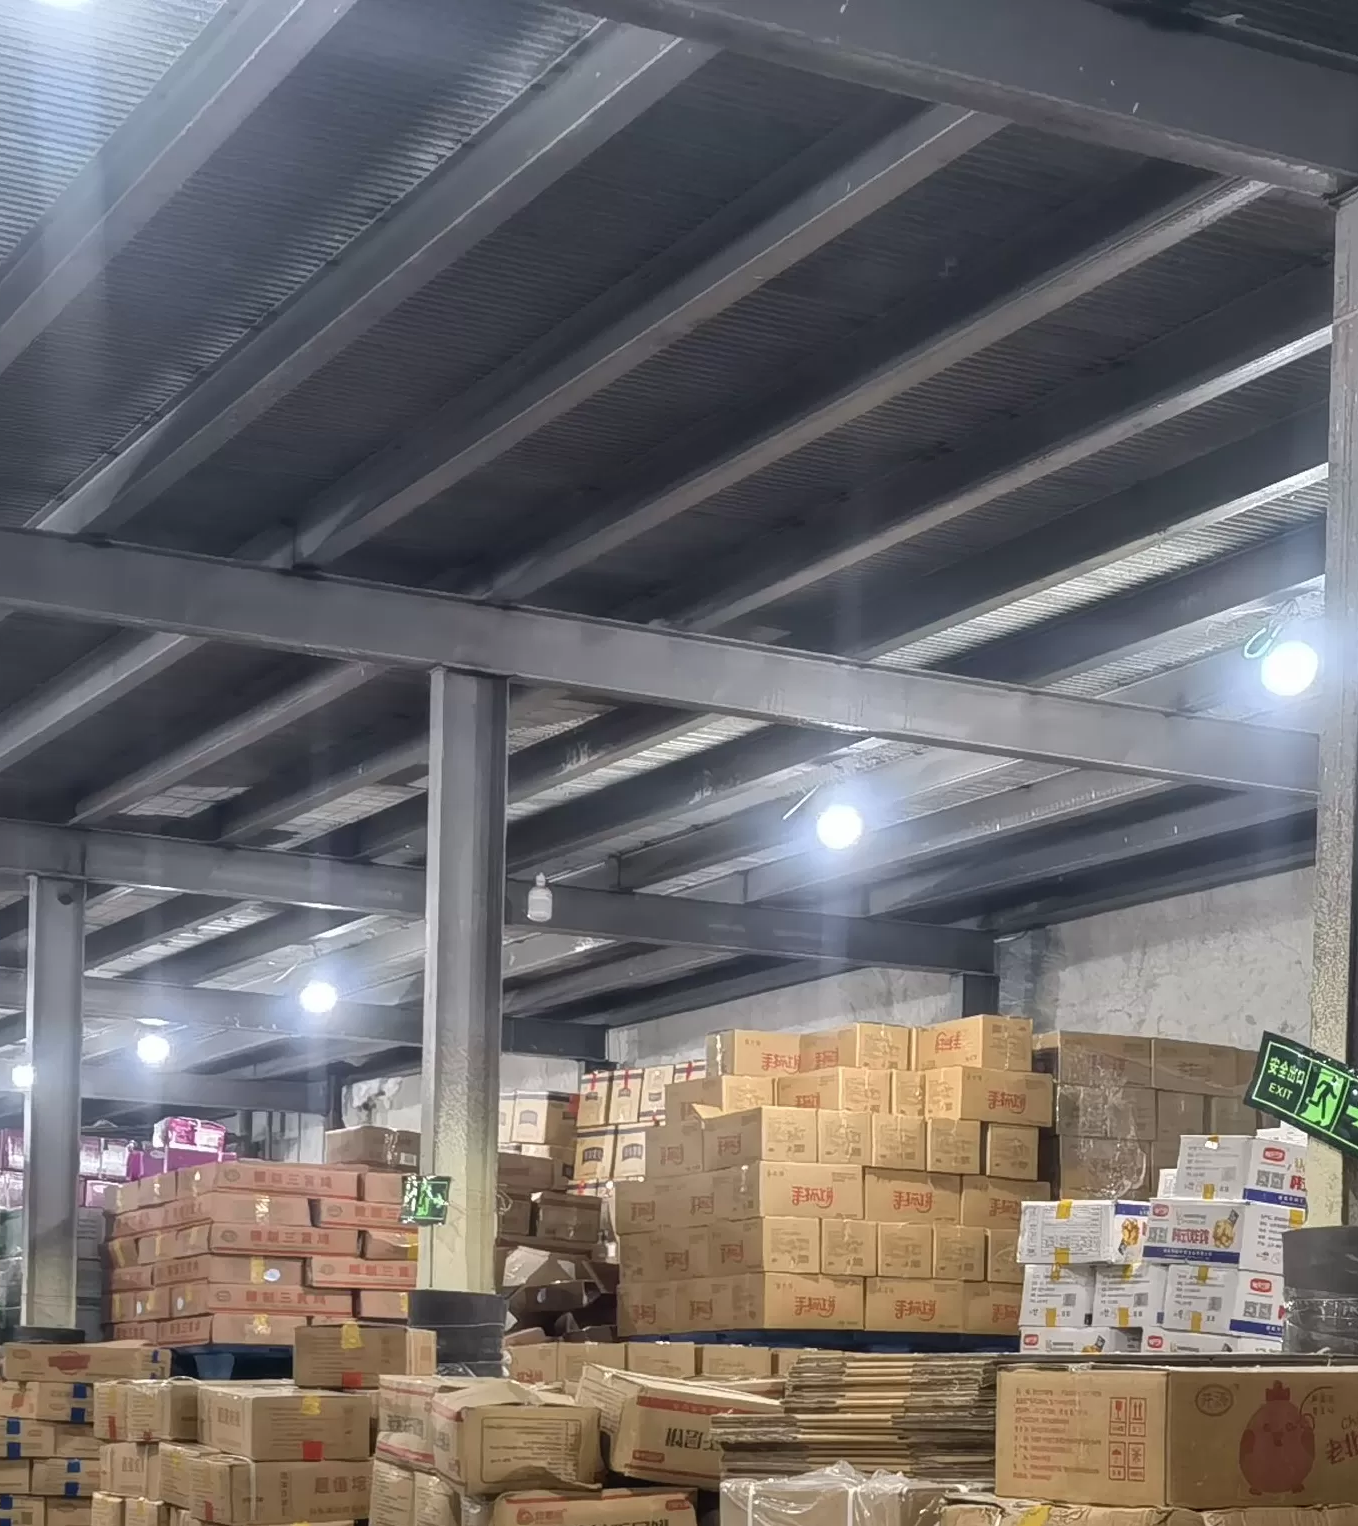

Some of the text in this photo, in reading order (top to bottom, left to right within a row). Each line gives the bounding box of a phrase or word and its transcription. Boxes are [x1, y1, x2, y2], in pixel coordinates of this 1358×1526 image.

[1268, 1057, 1305, 1085] 安全出口
[1268, 1083, 1293, 1100] EXIT
